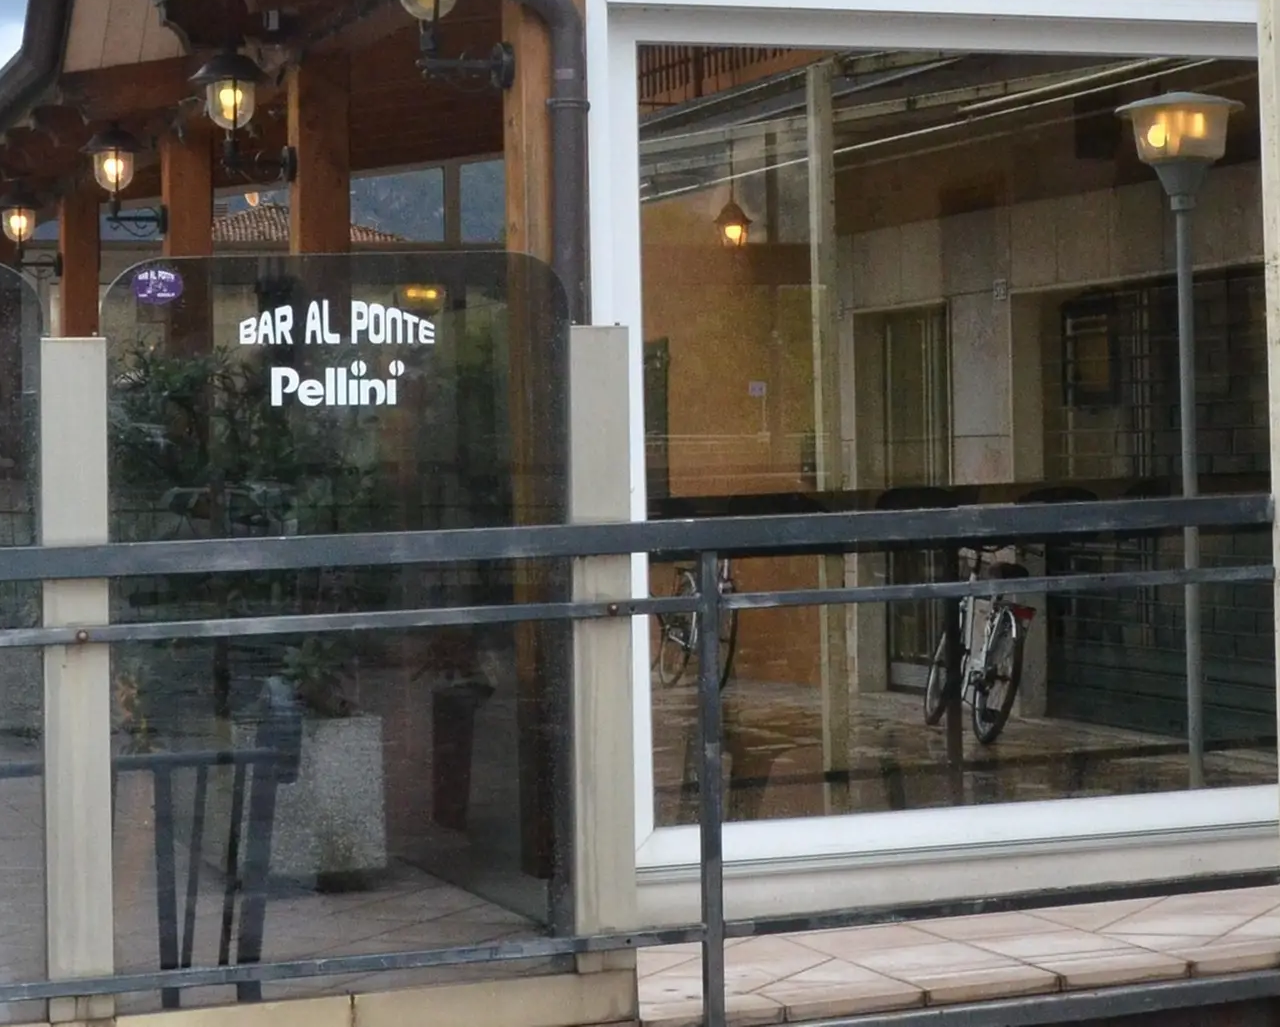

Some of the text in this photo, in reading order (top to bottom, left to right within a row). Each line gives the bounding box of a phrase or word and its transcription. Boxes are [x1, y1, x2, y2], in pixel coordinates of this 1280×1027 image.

[239, 299, 435, 344] BAR AL PONTE
[271, 360, 405, 406] Pellini
